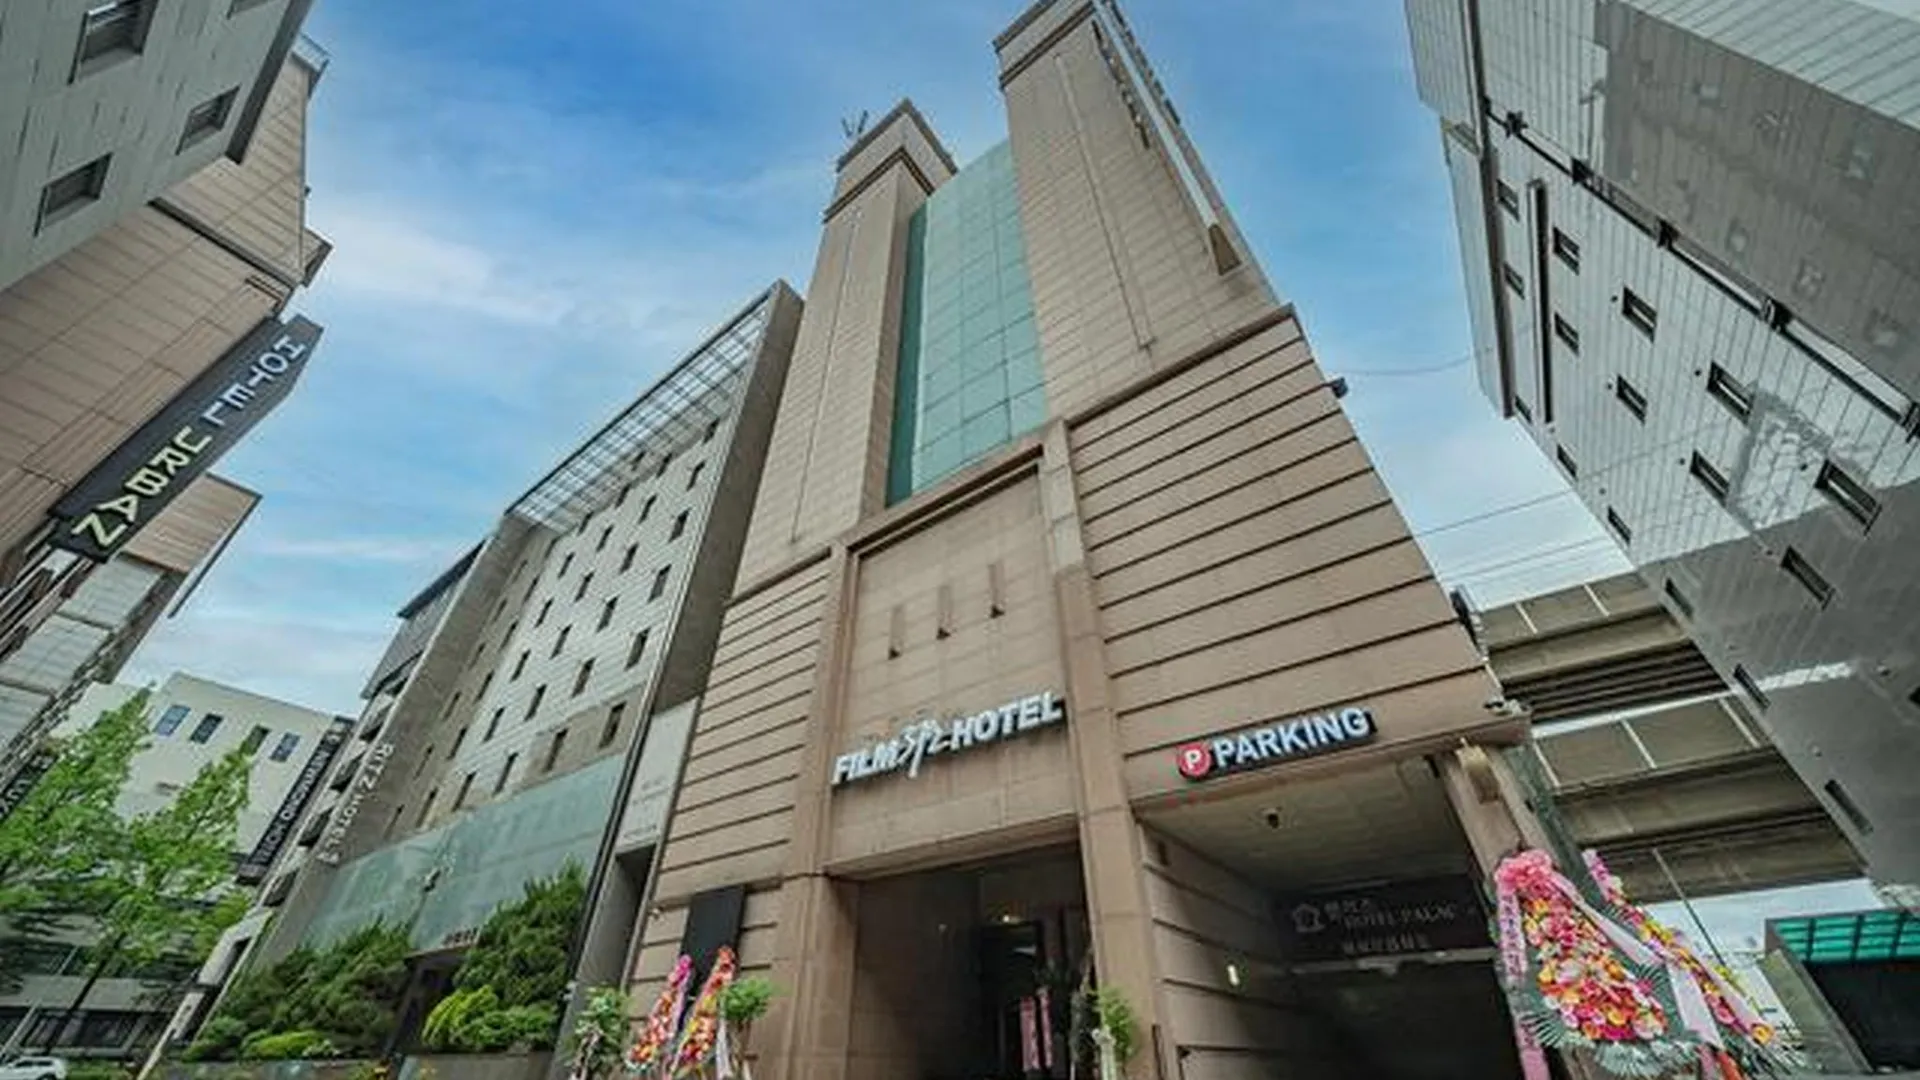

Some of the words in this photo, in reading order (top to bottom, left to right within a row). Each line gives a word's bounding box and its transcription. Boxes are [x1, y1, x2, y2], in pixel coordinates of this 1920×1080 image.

[203, 335, 305, 427] HOTEL
[72, 426, 212, 547] URBAN
[832, 740, 898, 784] FILM
[951, 692, 1062, 750] HOTEL
[1213, 707, 1371, 768] PARKING
